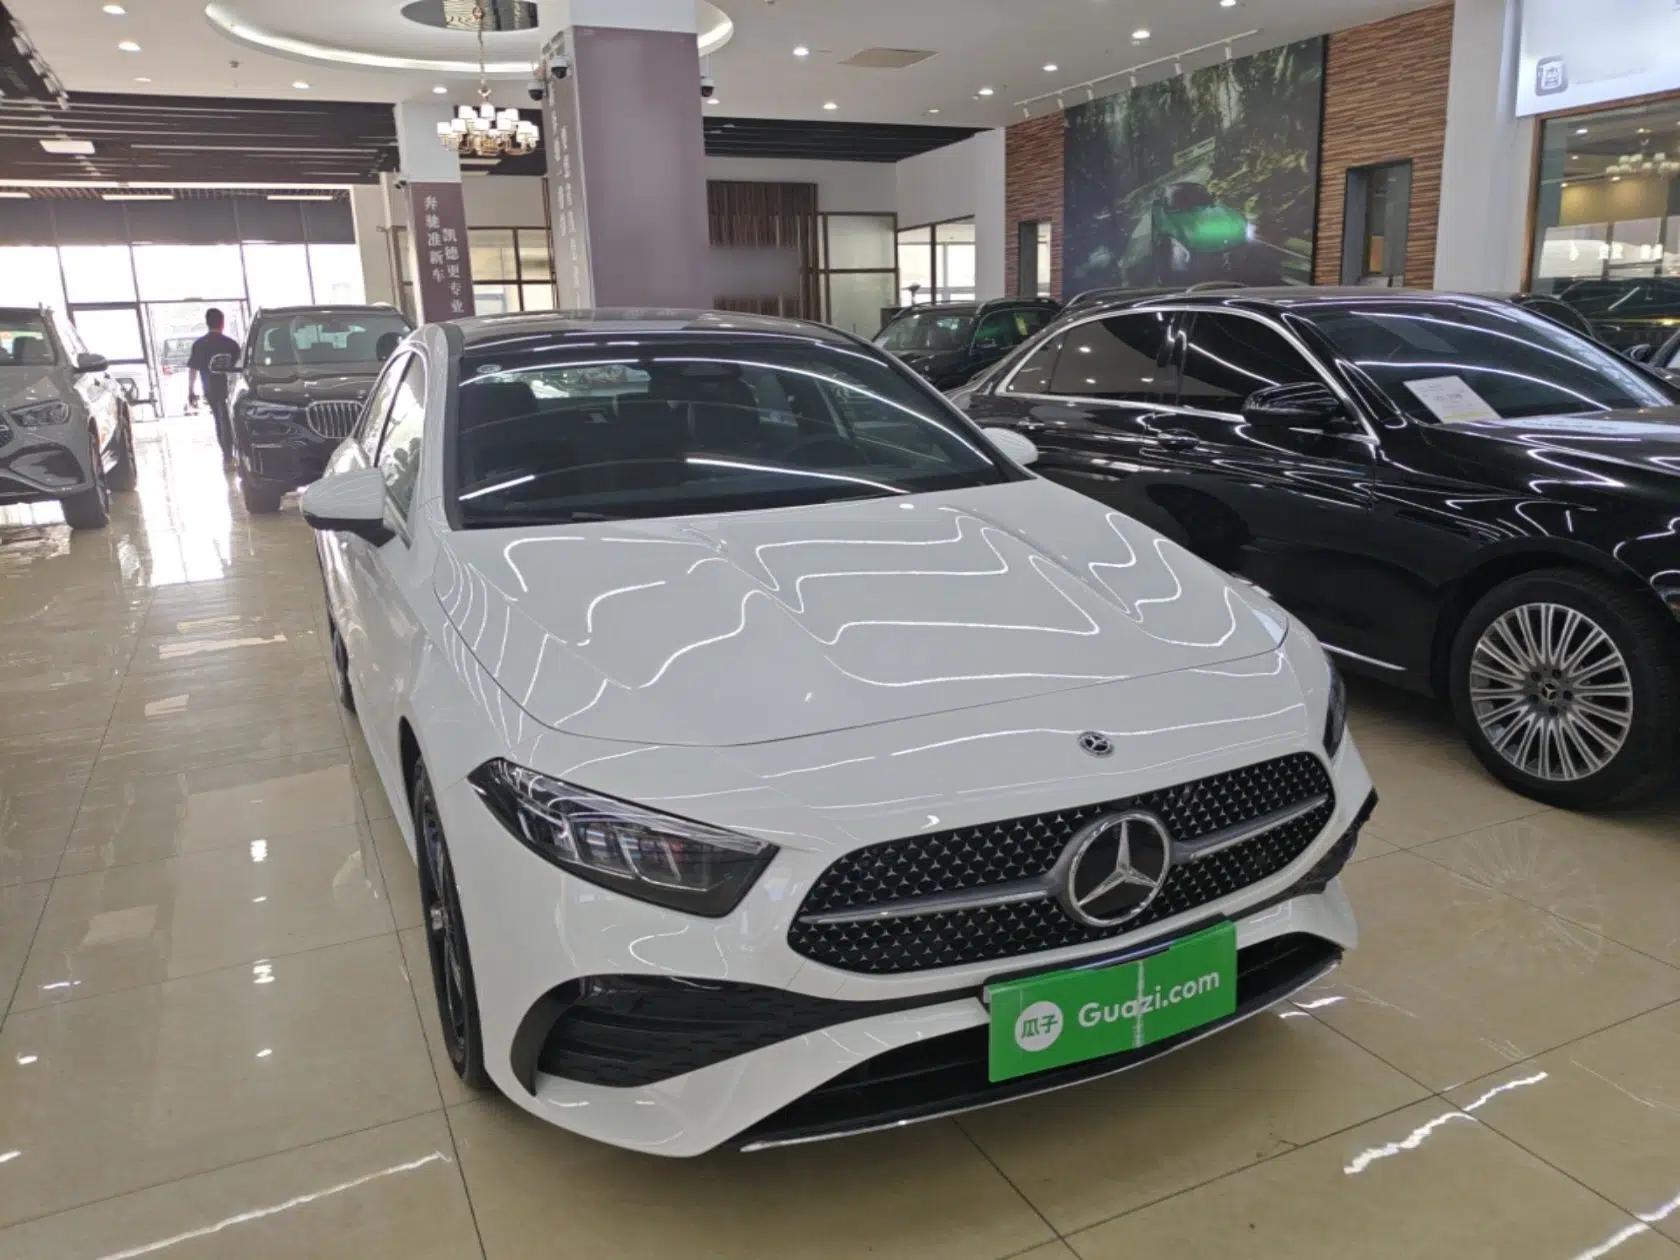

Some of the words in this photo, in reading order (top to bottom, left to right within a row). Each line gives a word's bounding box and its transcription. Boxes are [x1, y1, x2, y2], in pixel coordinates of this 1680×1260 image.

[424, 195, 445, 283] 奔驰准新车
[442, 228, 464, 313] 凯德更专业
[1021, 1014, 1058, 1039] 瓜子
[1078, 972, 1220, 1027] Guazi.com
